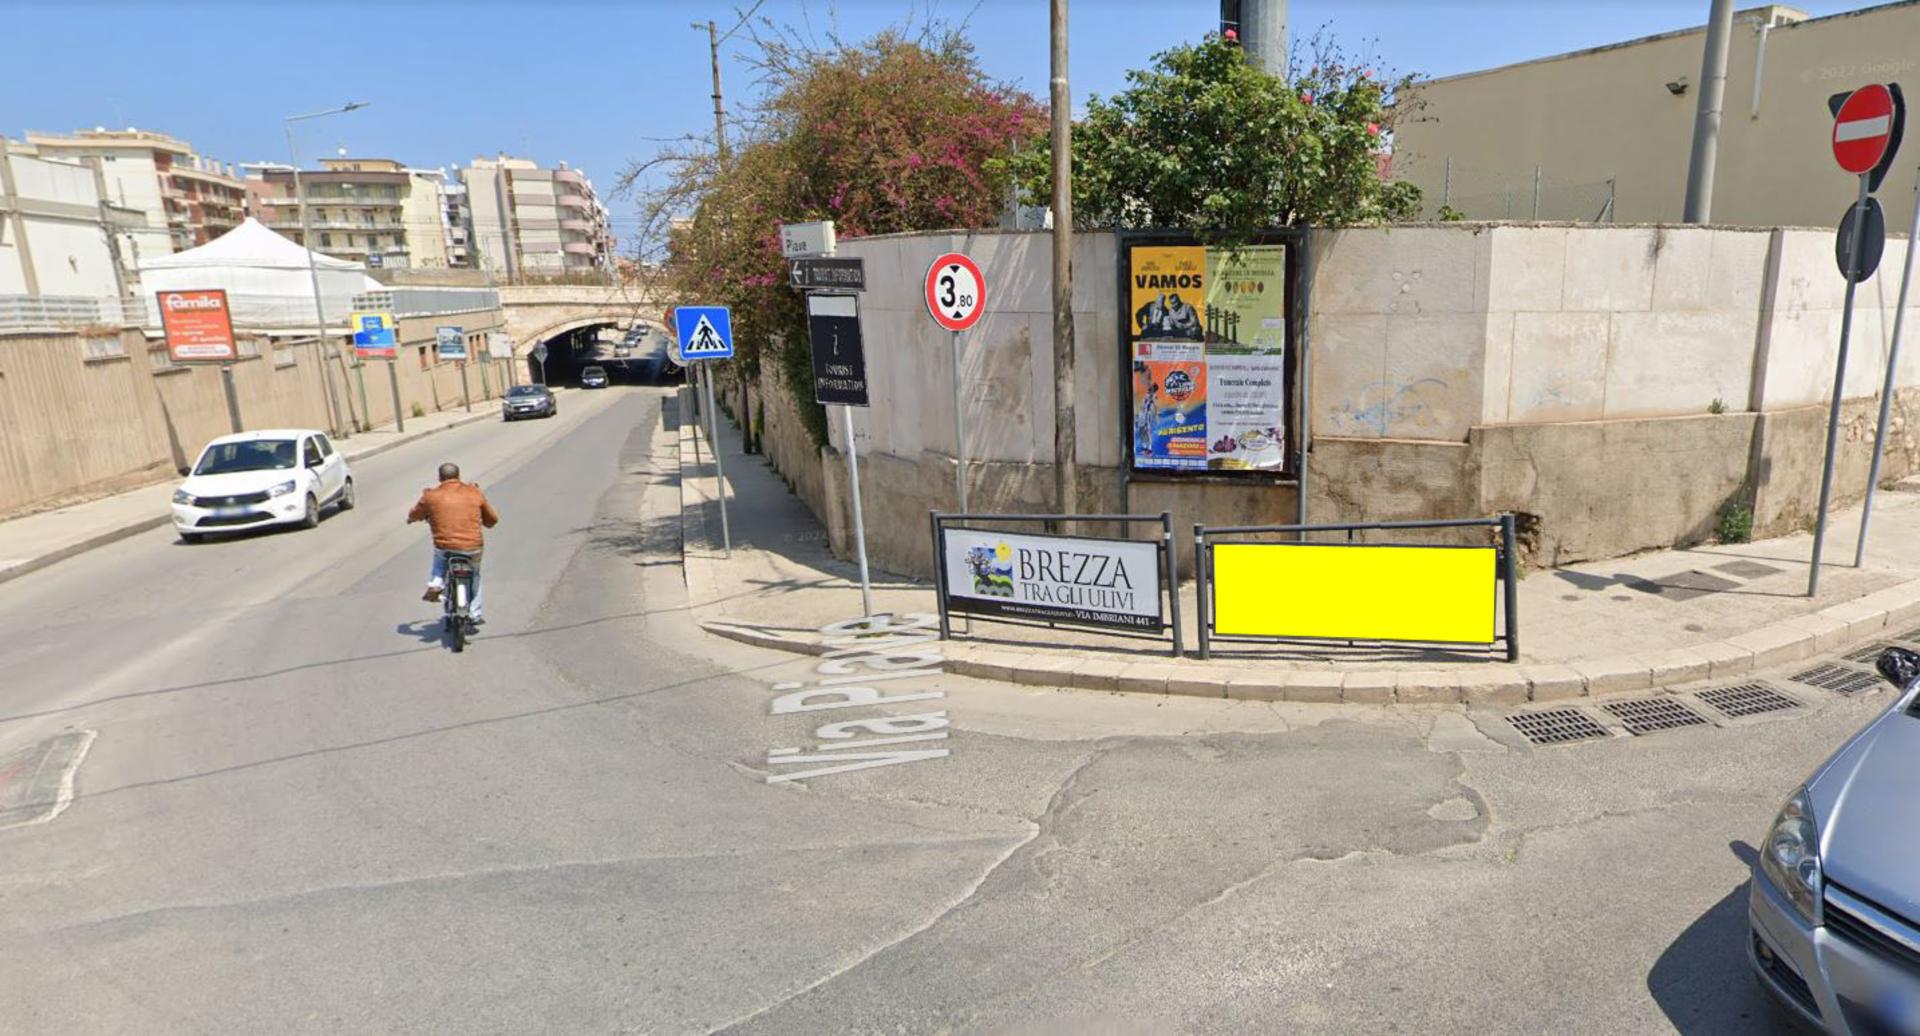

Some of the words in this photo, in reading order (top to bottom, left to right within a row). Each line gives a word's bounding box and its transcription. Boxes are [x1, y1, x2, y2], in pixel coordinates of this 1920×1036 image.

[785, 239, 807, 252] Piave
[1135, 274, 1203, 289] VAMOS
[166, 293, 222, 312] famila
[818, 378, 865, 392] INFORMATION
[1018, 548, 1134, 590] BREZZA
[1020, 582, 1054, 603] TRA
[1056, 585, 1083, 605] GLI
[1088, 588, 1135, 611] ULIVI
[1075, 610, 1091, 620] VIA
[1092, 611, 1135, 625] IMBRIANI
[1136, 616, 1150, 626] 441
